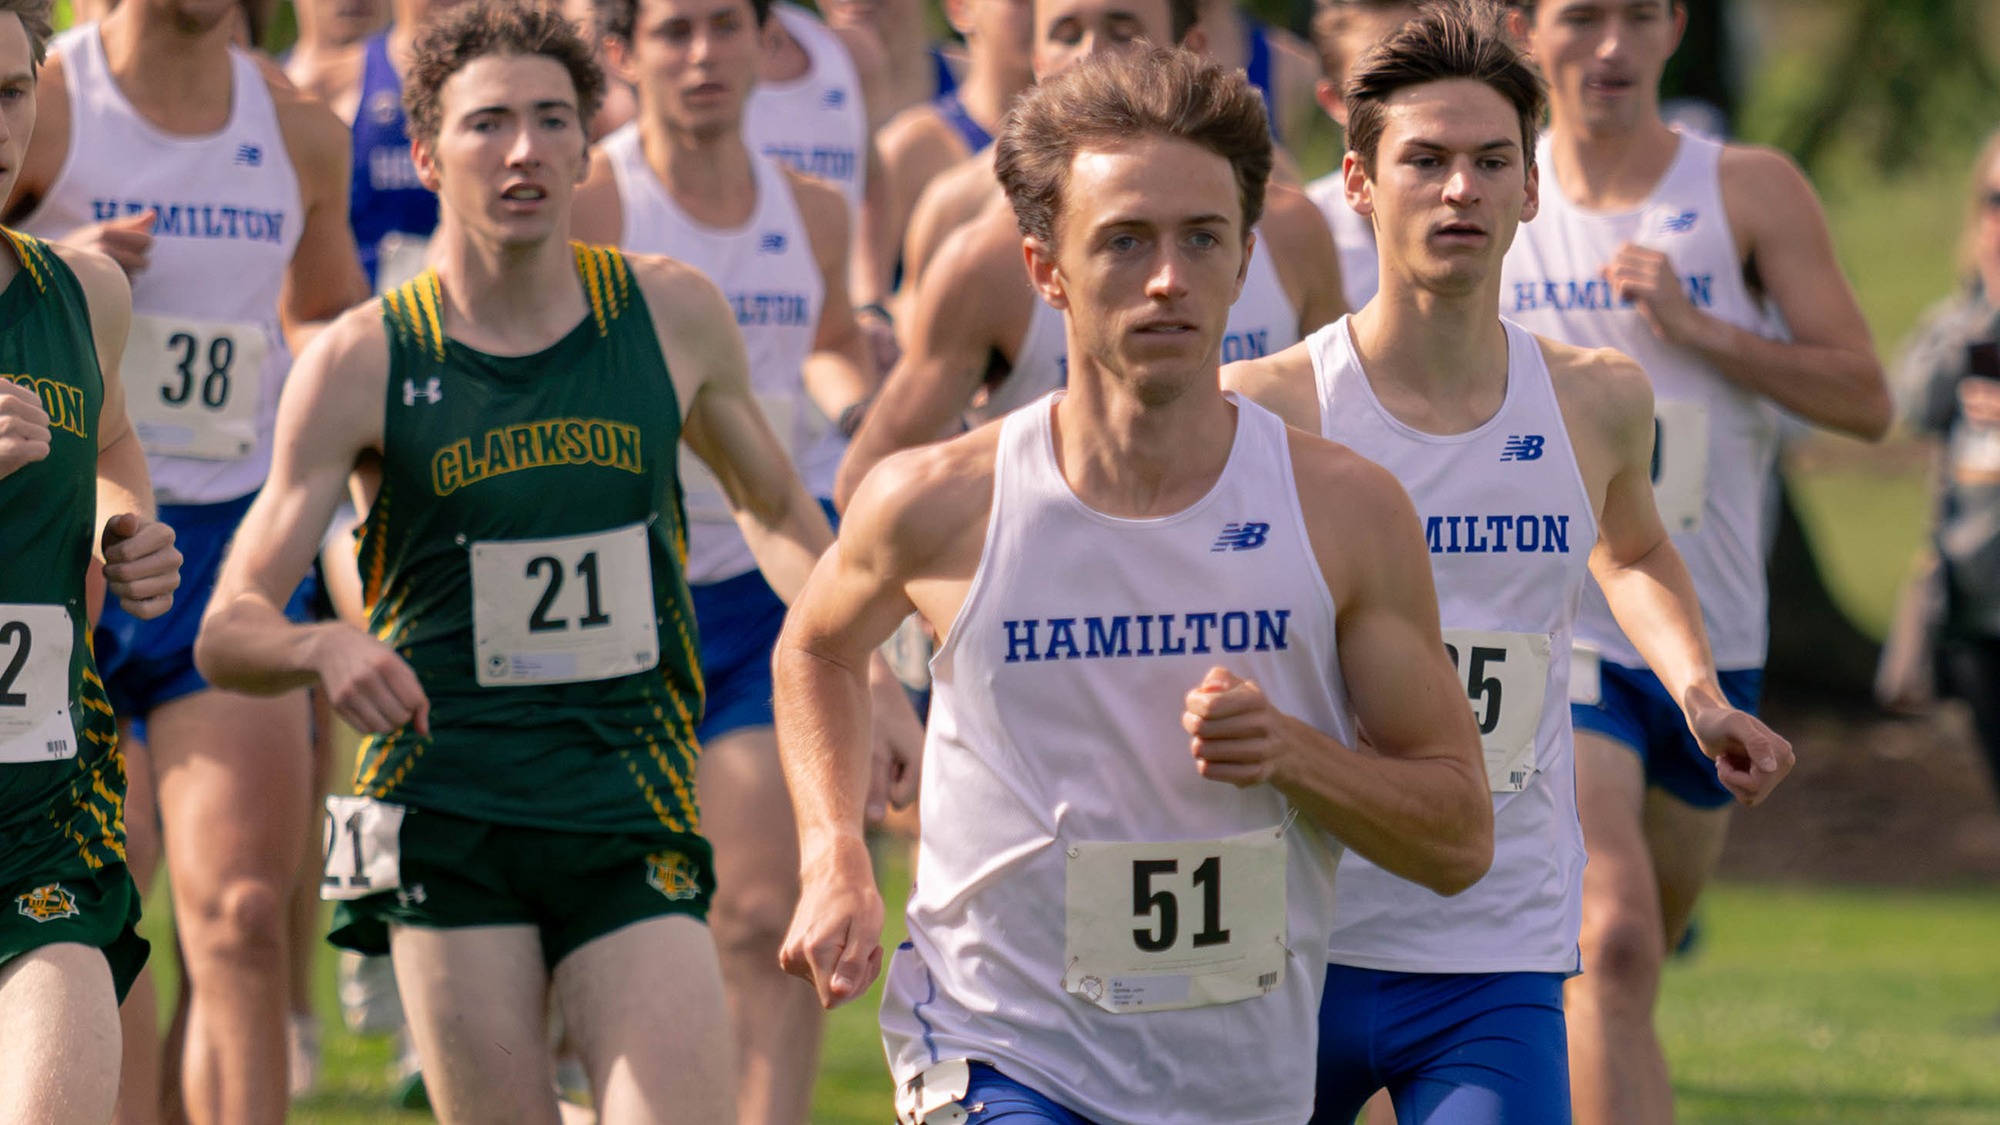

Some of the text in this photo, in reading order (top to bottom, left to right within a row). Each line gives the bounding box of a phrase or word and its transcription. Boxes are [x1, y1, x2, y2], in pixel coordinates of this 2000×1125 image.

[1513, 273, 1713, 312] HAMIN
[160, 332, 234, 408] 38
[432, 418, 642, 497] CLARKSON
[525, 551, 611, 632] 21
[1003, 609, 1291, 663] HAMILTON
[1444, 642, 1507, 735] 5
[1132, 856, 1230, 953] 51
